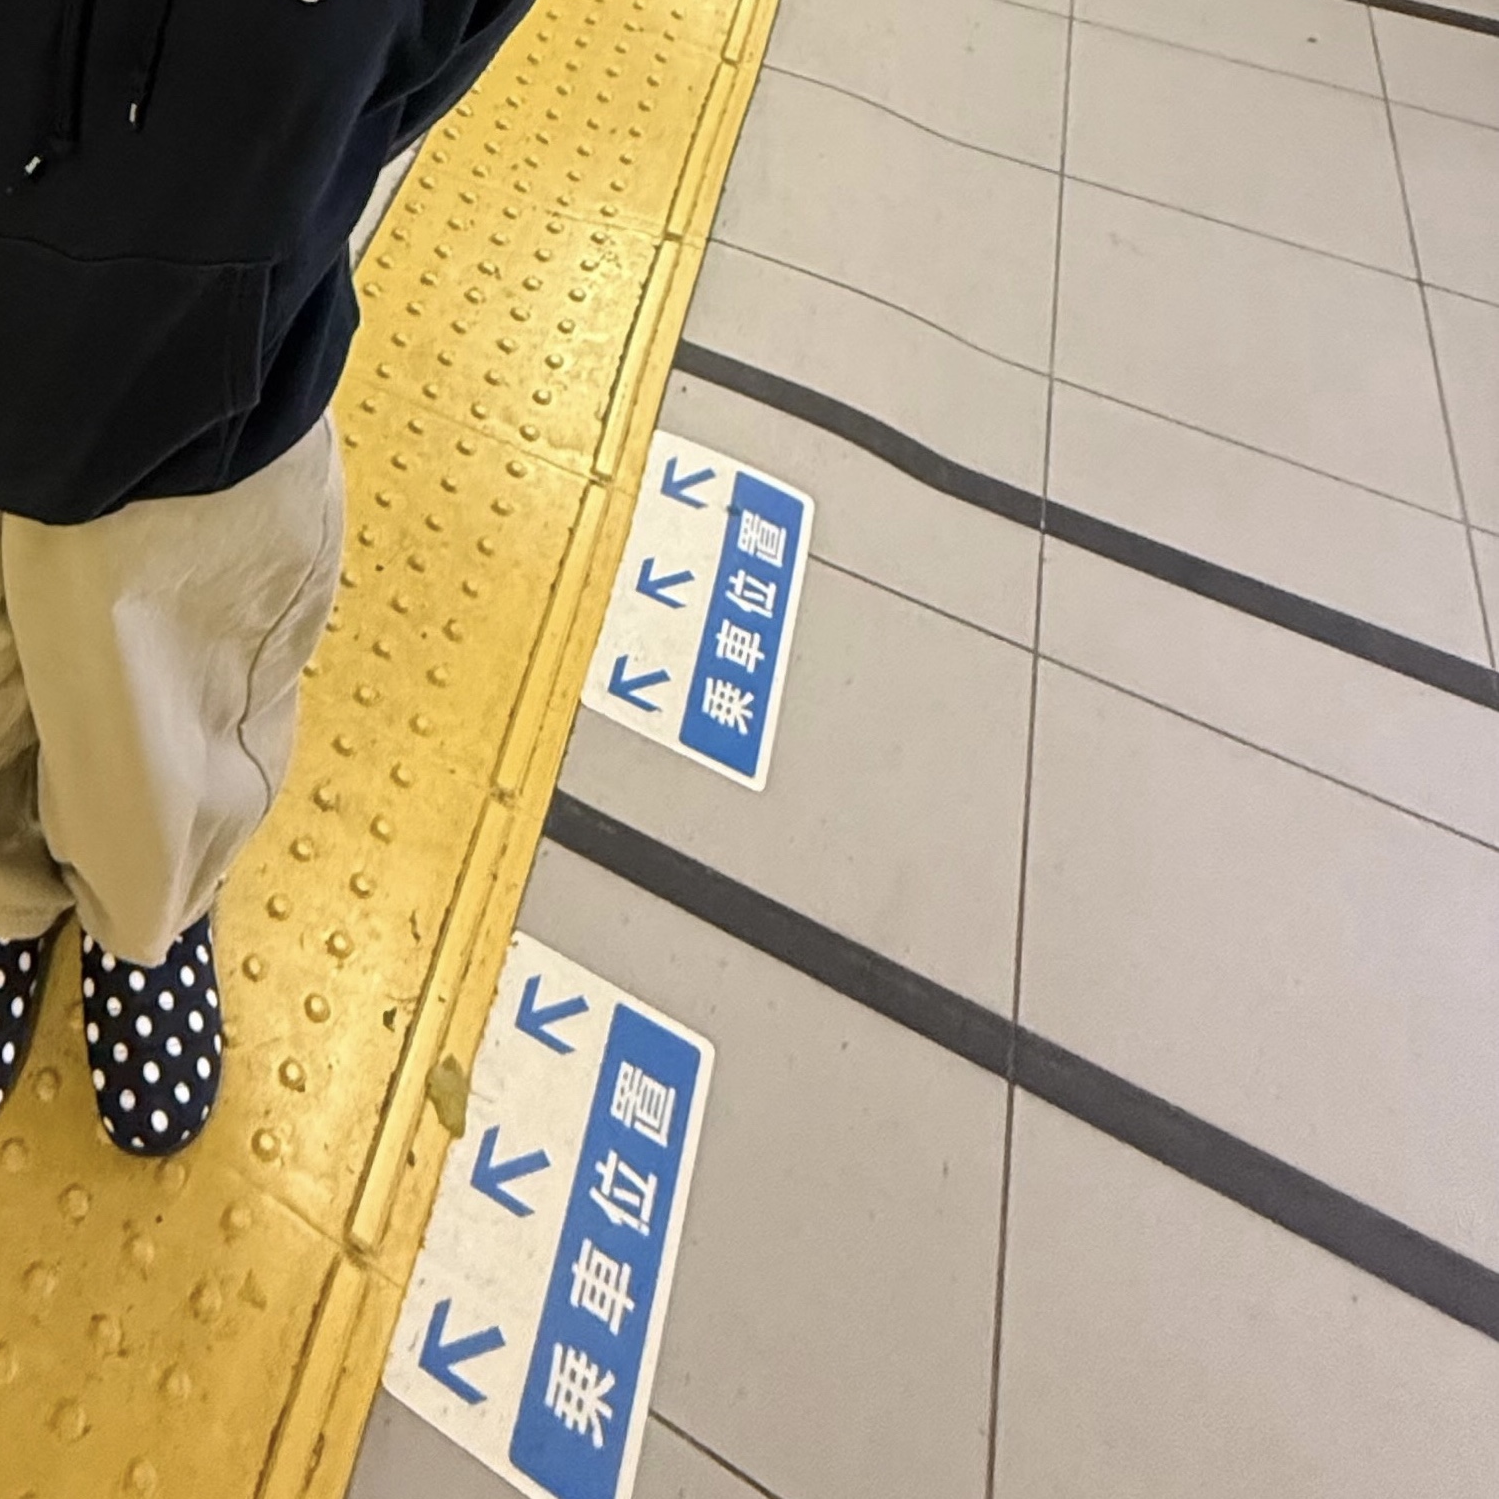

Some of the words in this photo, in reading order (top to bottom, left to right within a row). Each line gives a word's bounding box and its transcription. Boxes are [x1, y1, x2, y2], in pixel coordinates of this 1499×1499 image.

[702, 508, 787, 736] 乗車位置
[545, 1060, 676, 1449] 乗車位置
